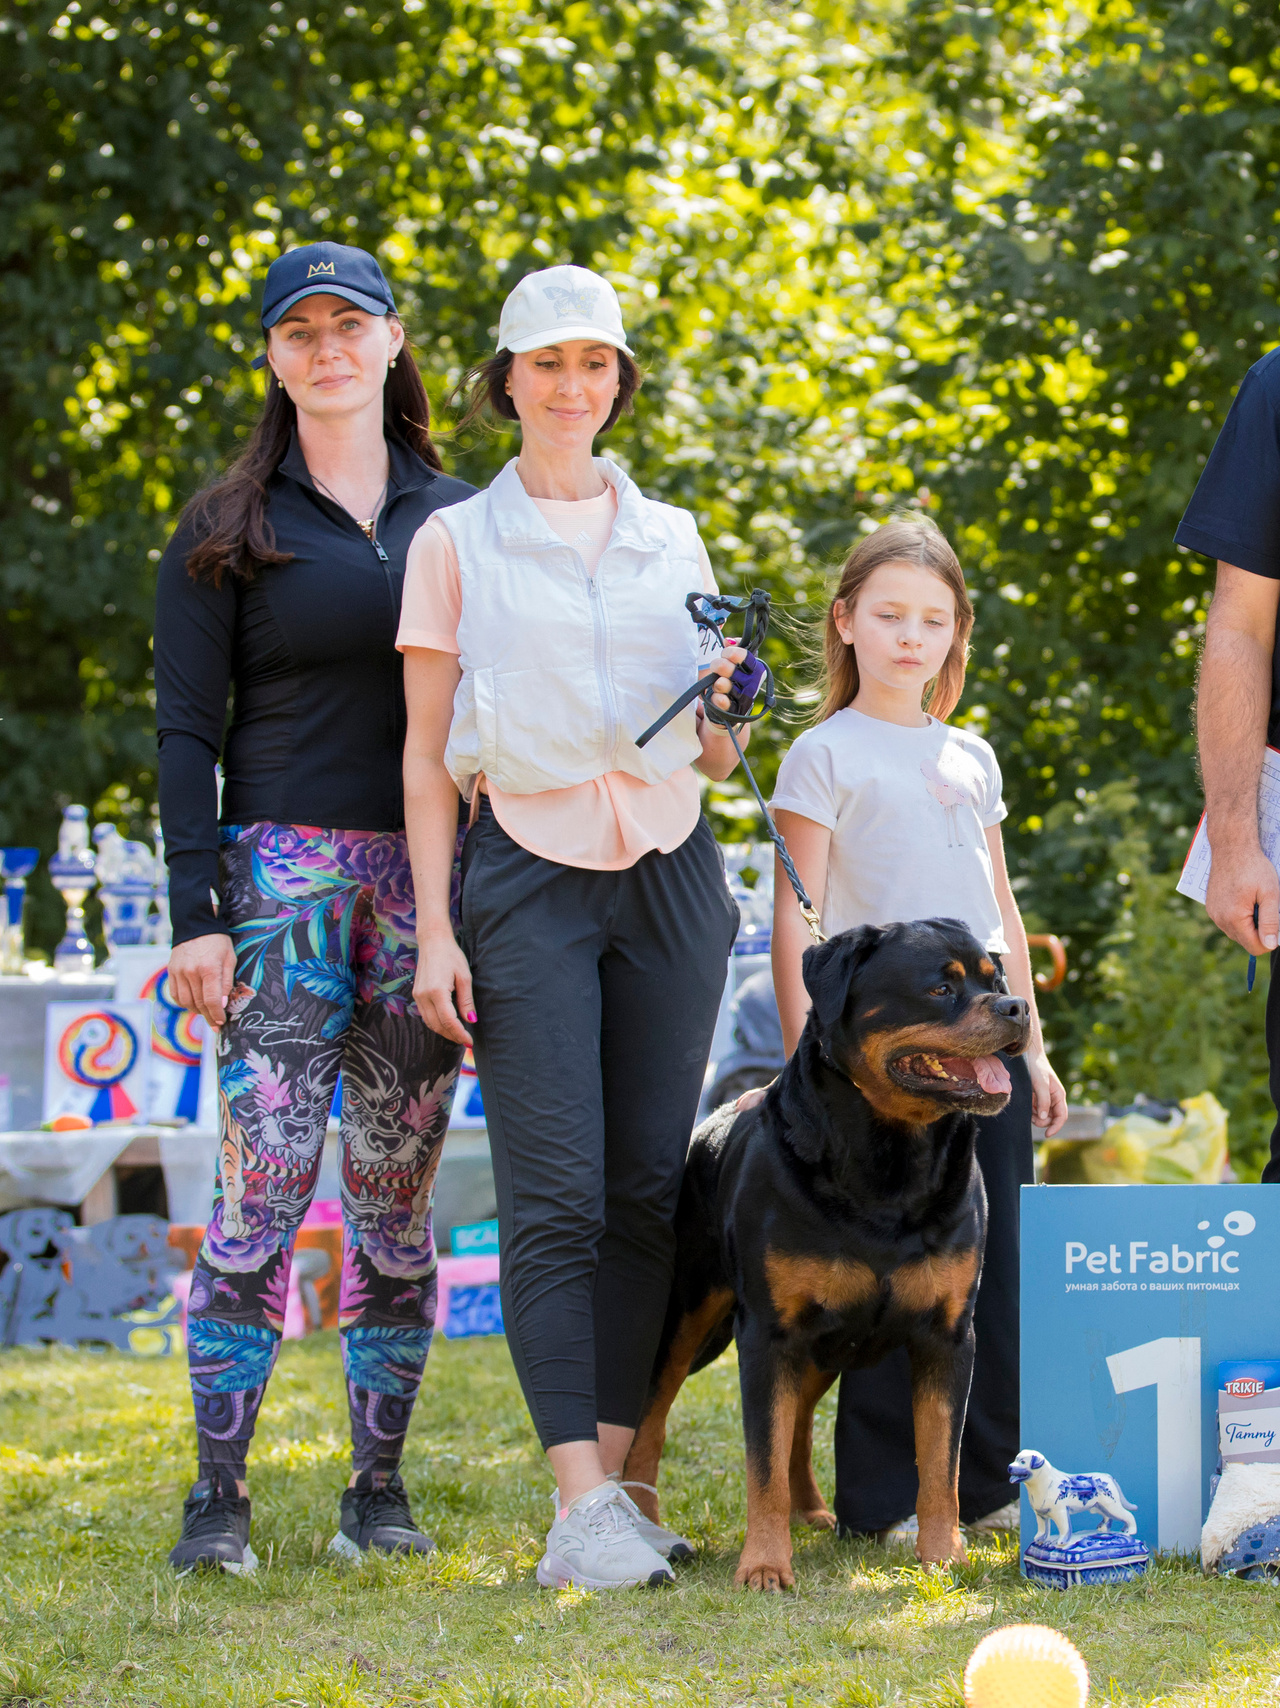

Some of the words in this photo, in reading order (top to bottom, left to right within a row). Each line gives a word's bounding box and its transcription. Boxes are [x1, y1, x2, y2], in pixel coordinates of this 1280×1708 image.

[1065, 1282, 1099, 1293] умная
[1101, 1280, 1138, 1291] забота
[1140, 1282, 1147, 1291] о
[1149, 1282, 1184, 1291] ваших
[1186, 1282, 1240, 1292] питомцах
[1225, 1381, 1264, 1394] TRIXIE
[1225, 1422, 1277, 1448] Tammy
[1106, 1337, 1201, 1556] 1
